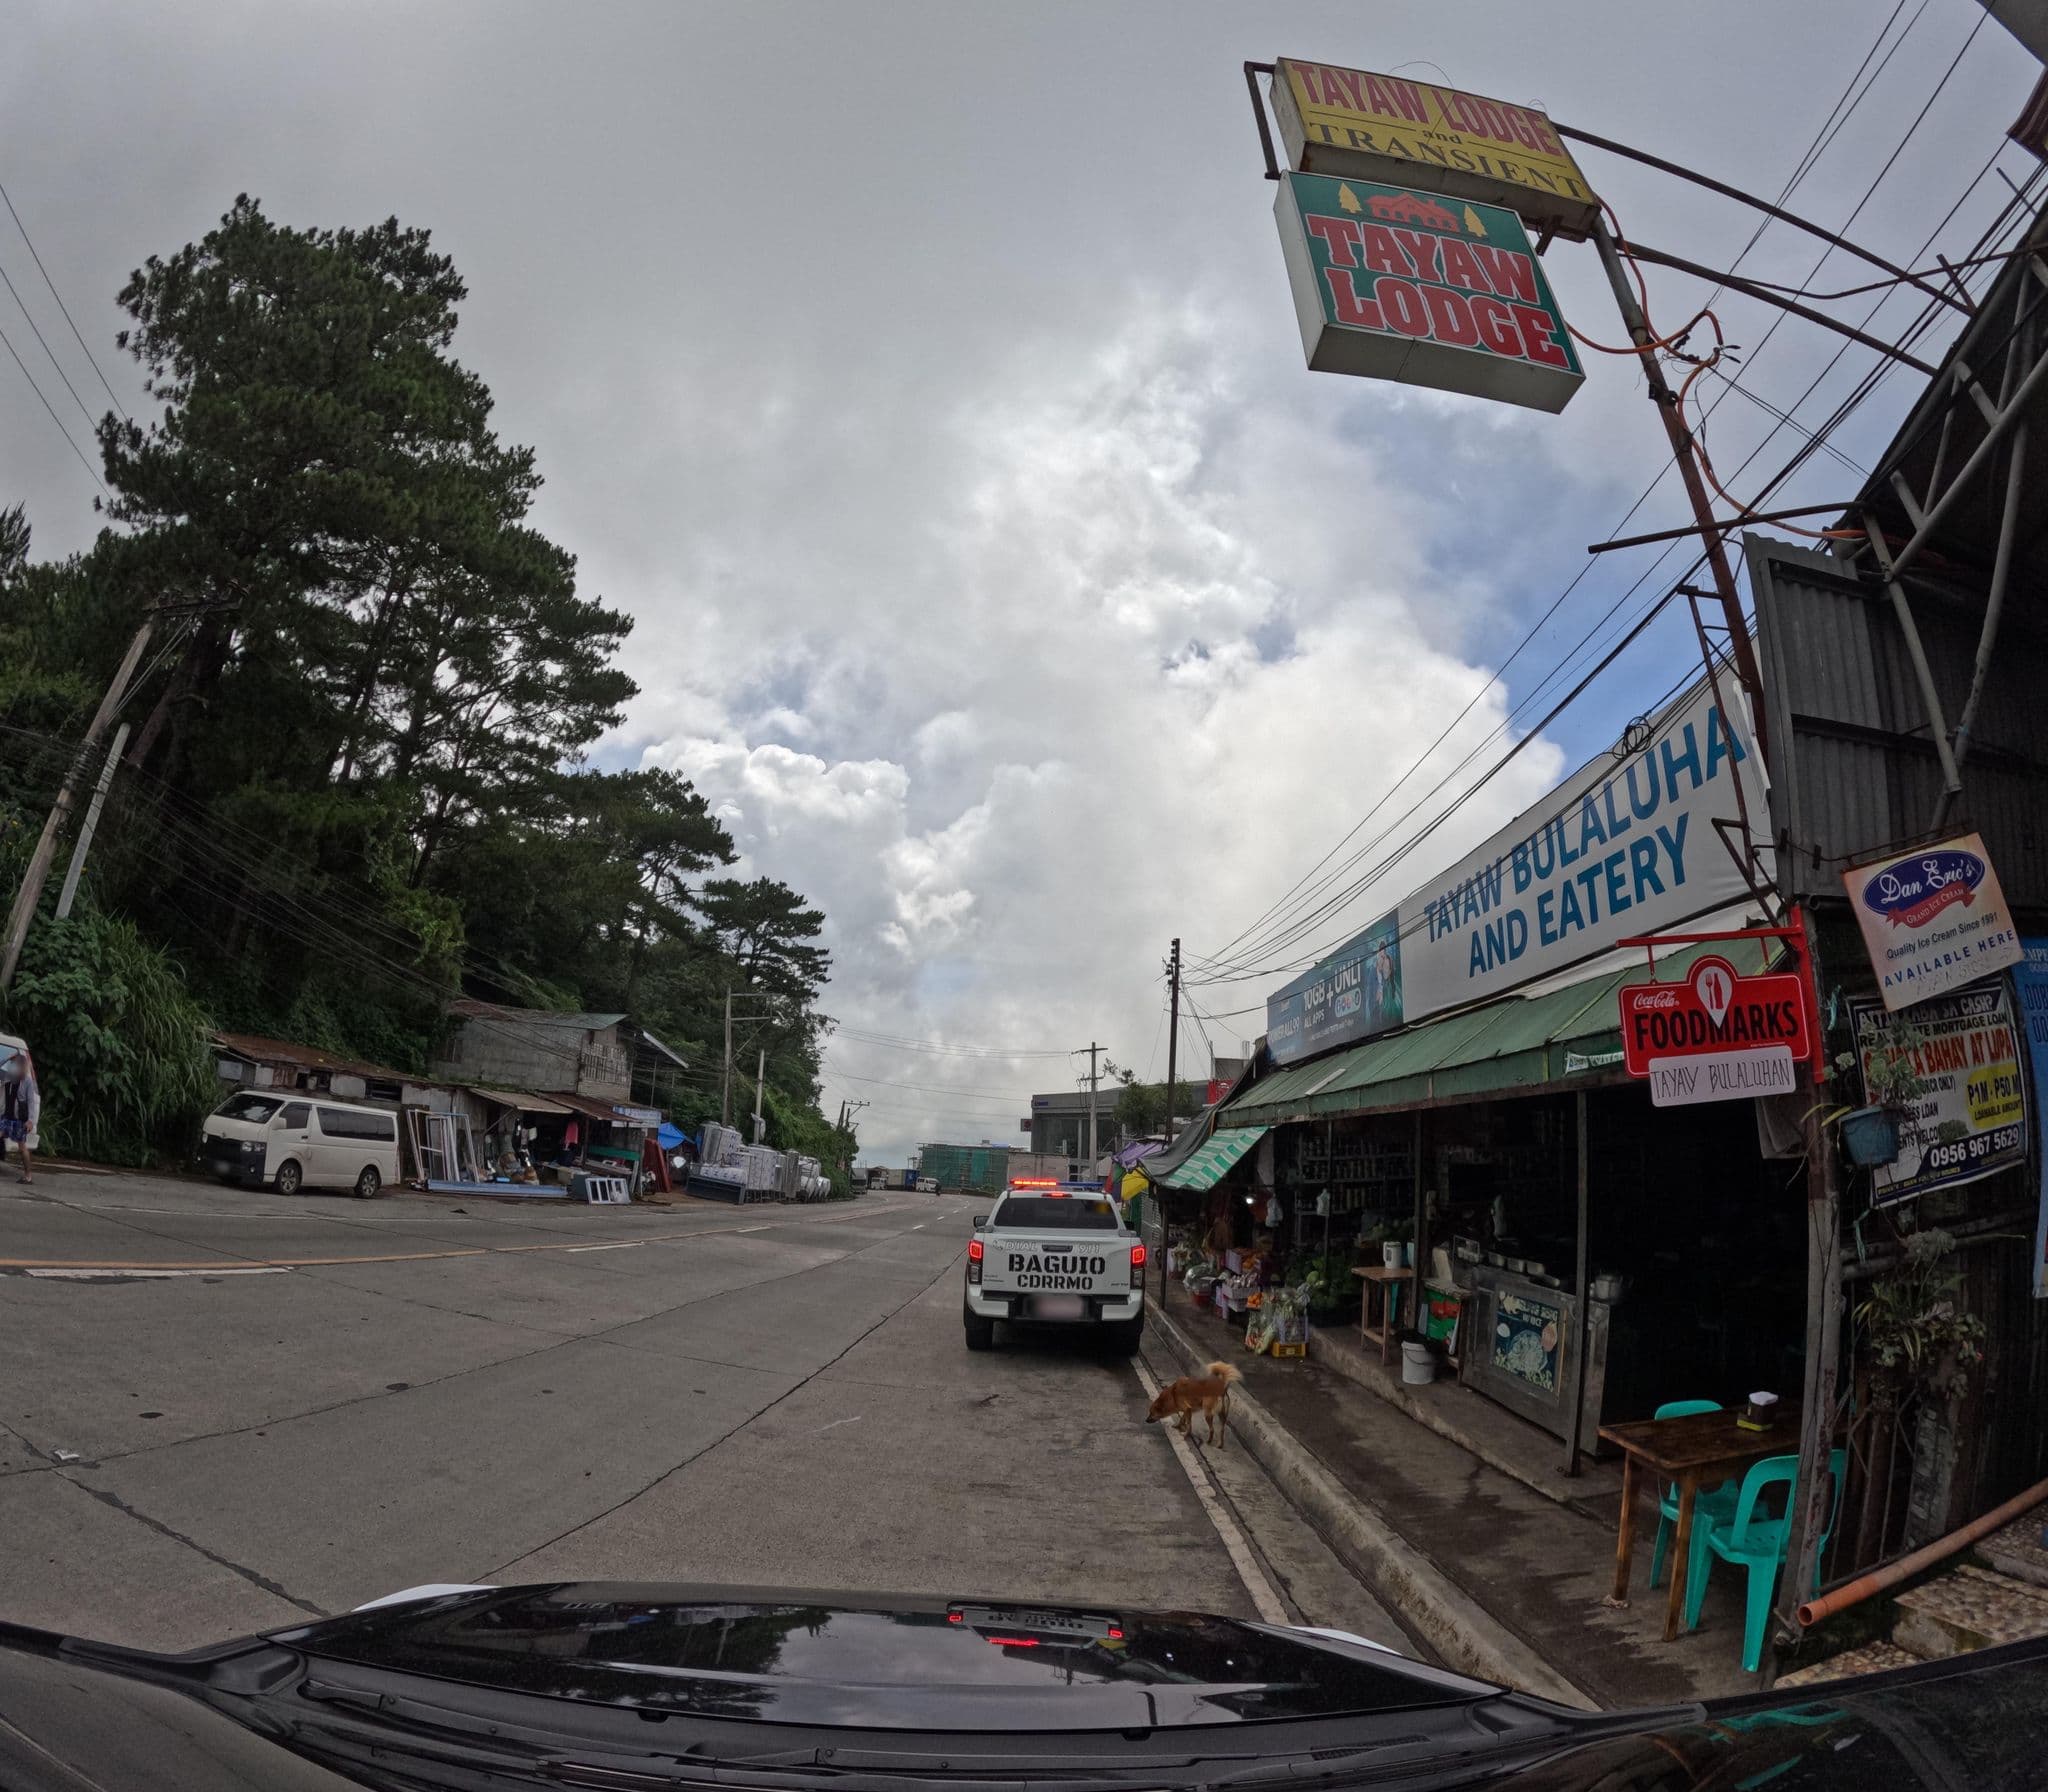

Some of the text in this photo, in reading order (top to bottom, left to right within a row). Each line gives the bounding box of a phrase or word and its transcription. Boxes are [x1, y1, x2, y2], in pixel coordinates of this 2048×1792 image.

[1291, 63, 1563, 156] TAYAW LODGE
[1309, 121, 1582, 199] TRANSIENT
[1423, 130, 1462, 144] and
[1305, 213, 1541, 304] TAYAW
[1323, 267, 1570, 369] LODGE
[1423, 856, 1504, 944] TAYAW
[1468, 813, 1690, 978] AND EATERY
[1879, 859, 1976, 904] Dan Eric's
[1884, 946, 1972, 988] AVAILABLE
[1978, 929, 2015, 952] HERE
[1886, 911, 1998, 961] Quality Ice Cream Since 1991
[1634, 1000, 1799, 1051] FOODMARKS
[1932, 1015, 1985, 1035] MORTGAGE
[1925, 1034, 1968, 1074] BAHAY
[1969, 1031, 1986, 1065] AT
[1985, 1026, 2015, 1061] LUPA
[1708, 1058, 1791, 1093] BULALUHAN
[1967, 1083, 1988, 1106] P1M
[1994, 1079, 2011, 1100] P50
[1930, 1140, 1967, 1168] 0956
[1968, 1134, 1991, 1158] 967
[1993, 1127, 2019, 1151] 5629
[1008, 1253, 1106, 1275] BAGUIO
[1017, 1274, 1093, 1290] CDRRMO
